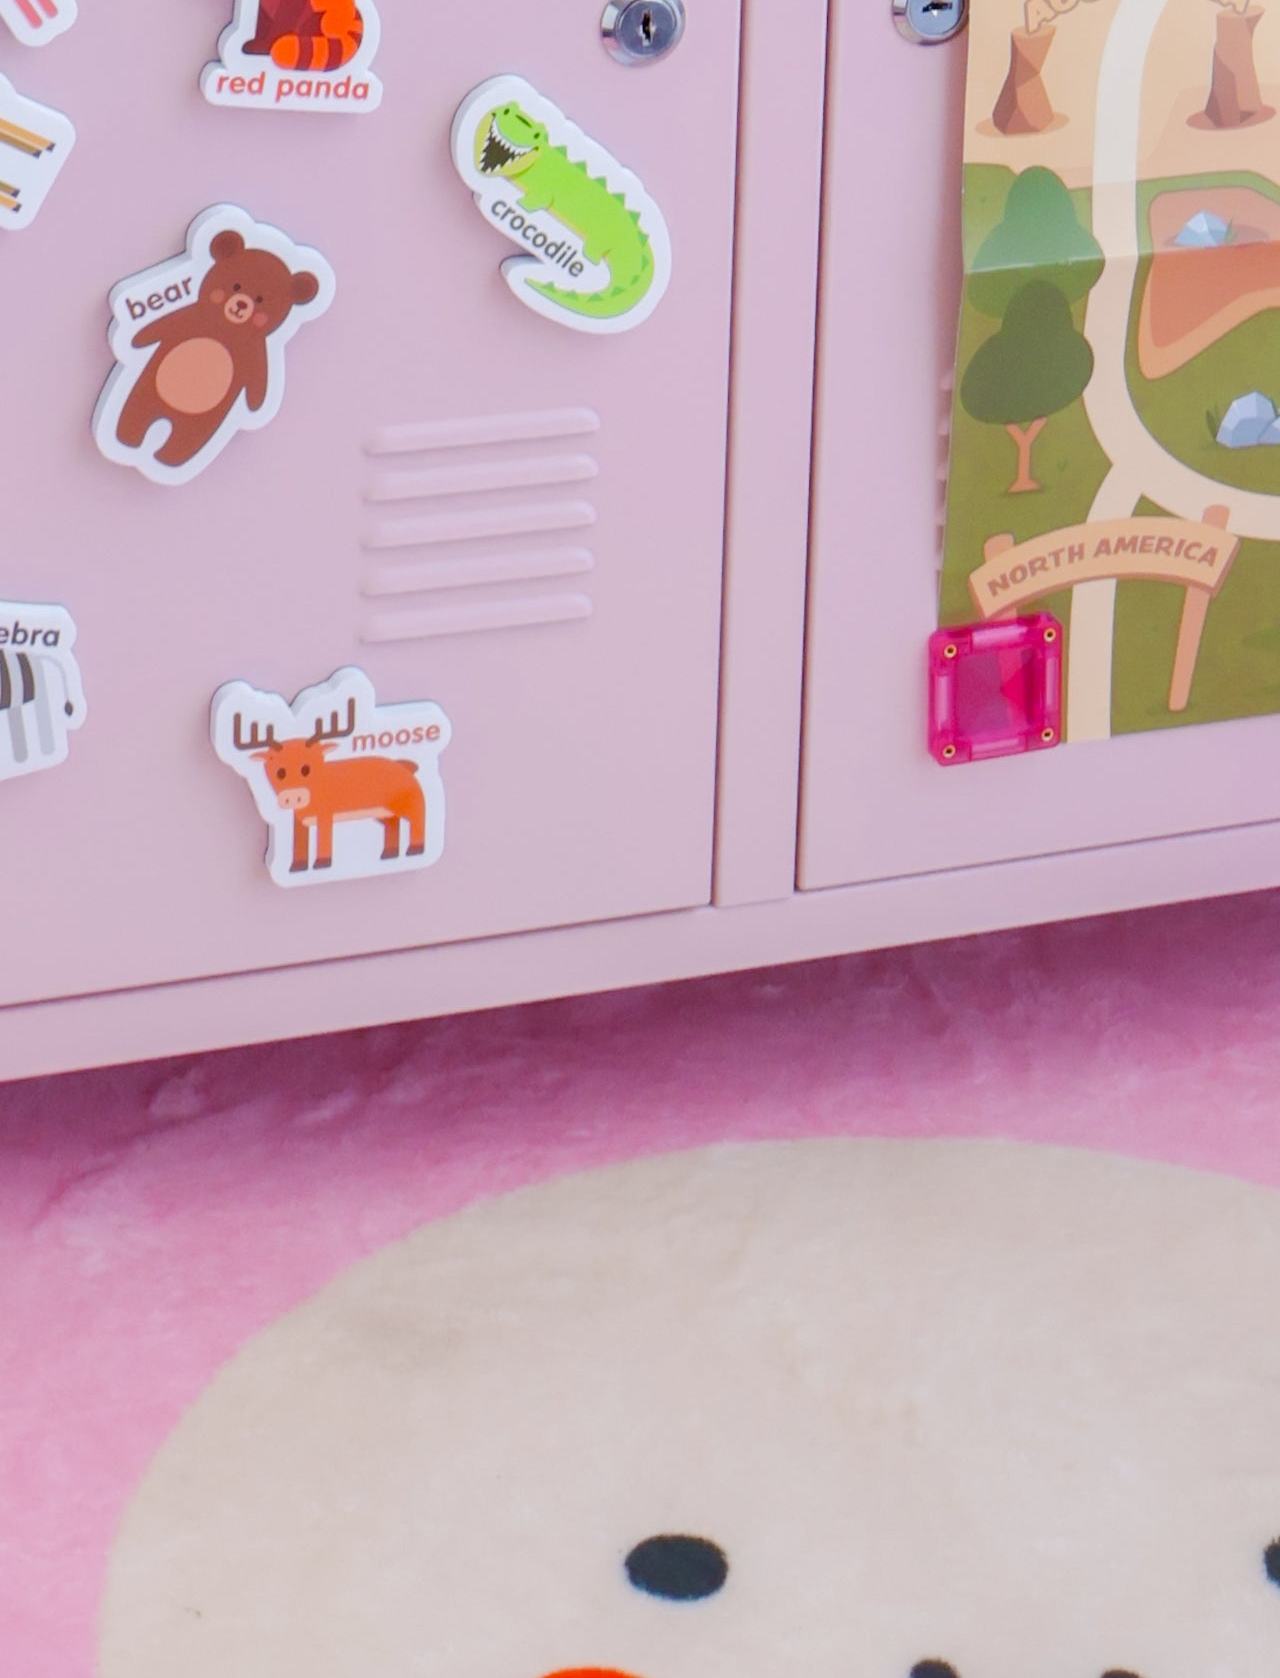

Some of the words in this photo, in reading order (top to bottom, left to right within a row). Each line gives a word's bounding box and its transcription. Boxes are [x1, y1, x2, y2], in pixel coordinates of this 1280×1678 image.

[216, 71, 267, 100] red
[276, 72, 370, 105] panda
[491, 196, 586, 279] crocodile
[125, 276, 194, 322] bear
[986, 542, 1085, 597] NORTH
[1093, 535, 1219, 567] AMERICA
[351, 720, 441, 753] moose
